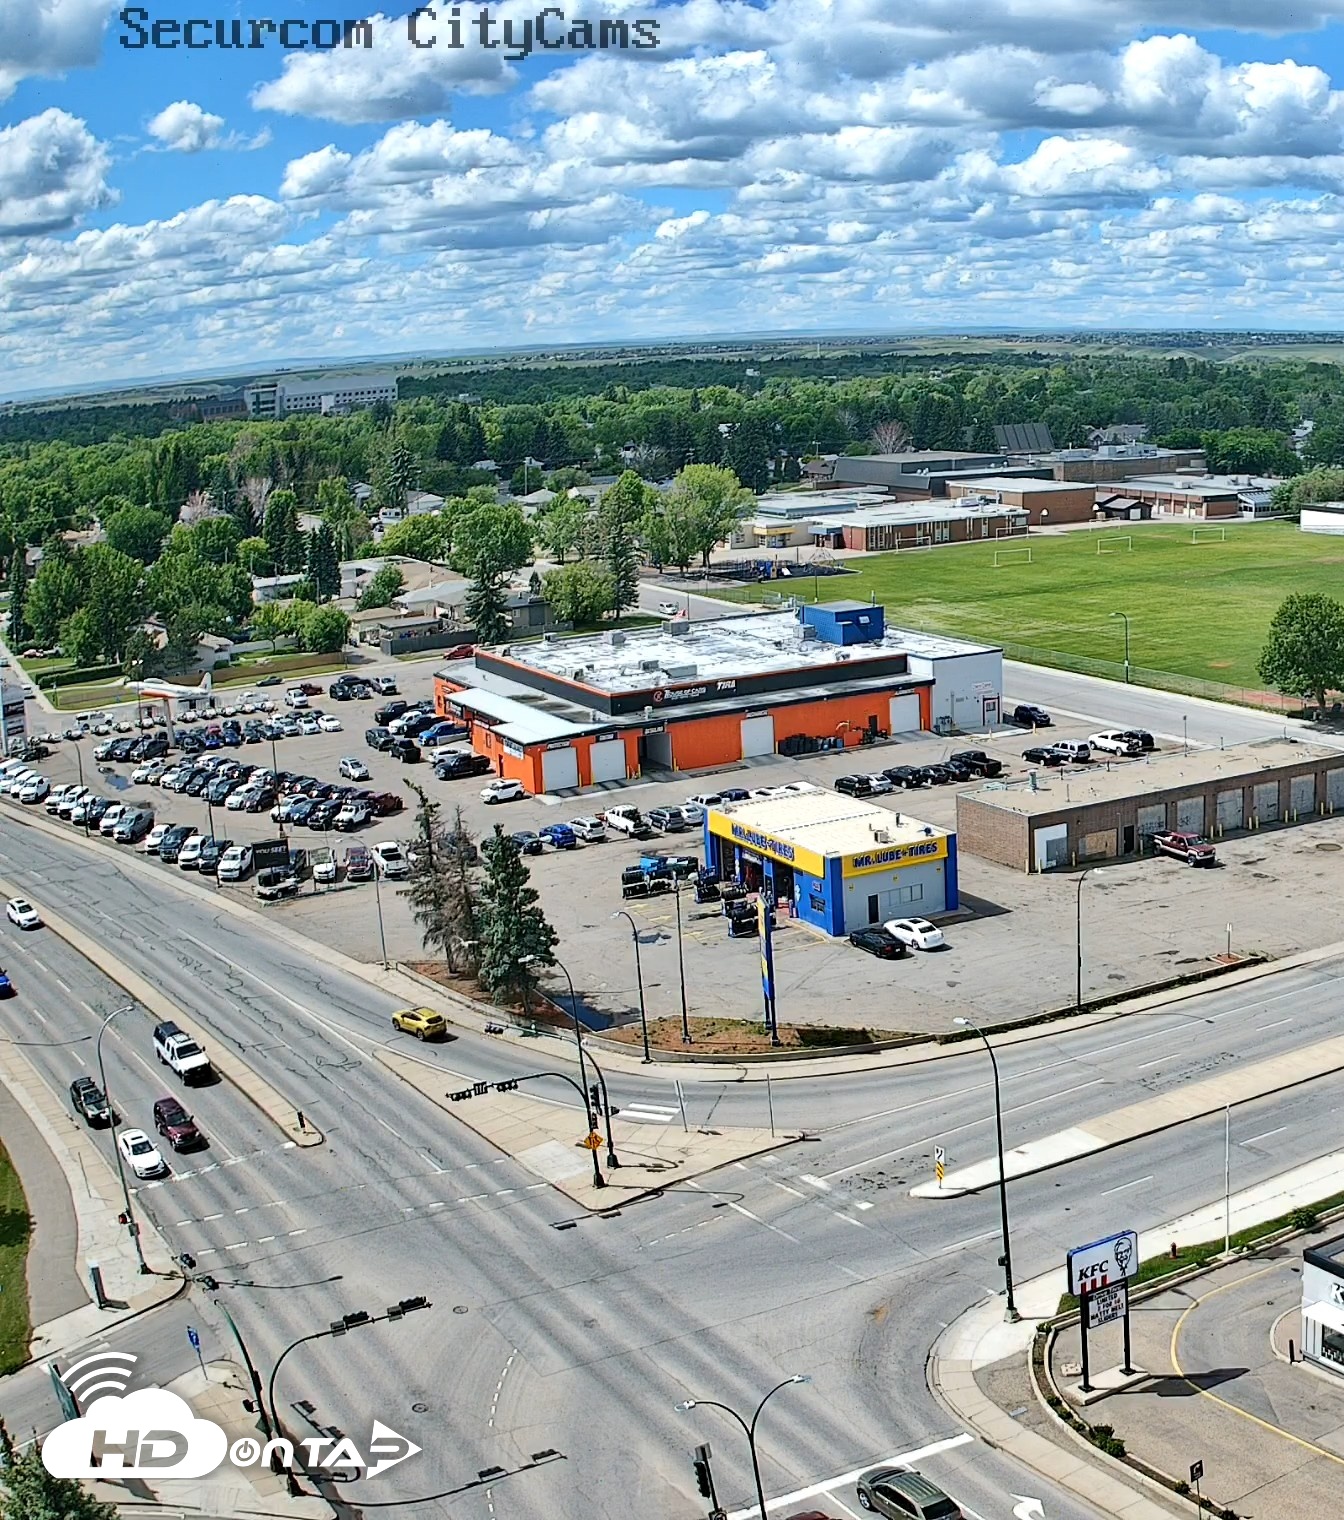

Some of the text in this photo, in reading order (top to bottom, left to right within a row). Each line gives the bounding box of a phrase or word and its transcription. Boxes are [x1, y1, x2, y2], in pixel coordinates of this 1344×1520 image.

[853, 854, 875, 867] MR.
[876, 849, 901, 863] LUBE
[908, 841, 938, 857] TIRES
[1078, 1260, 1109, 1281] KFC
